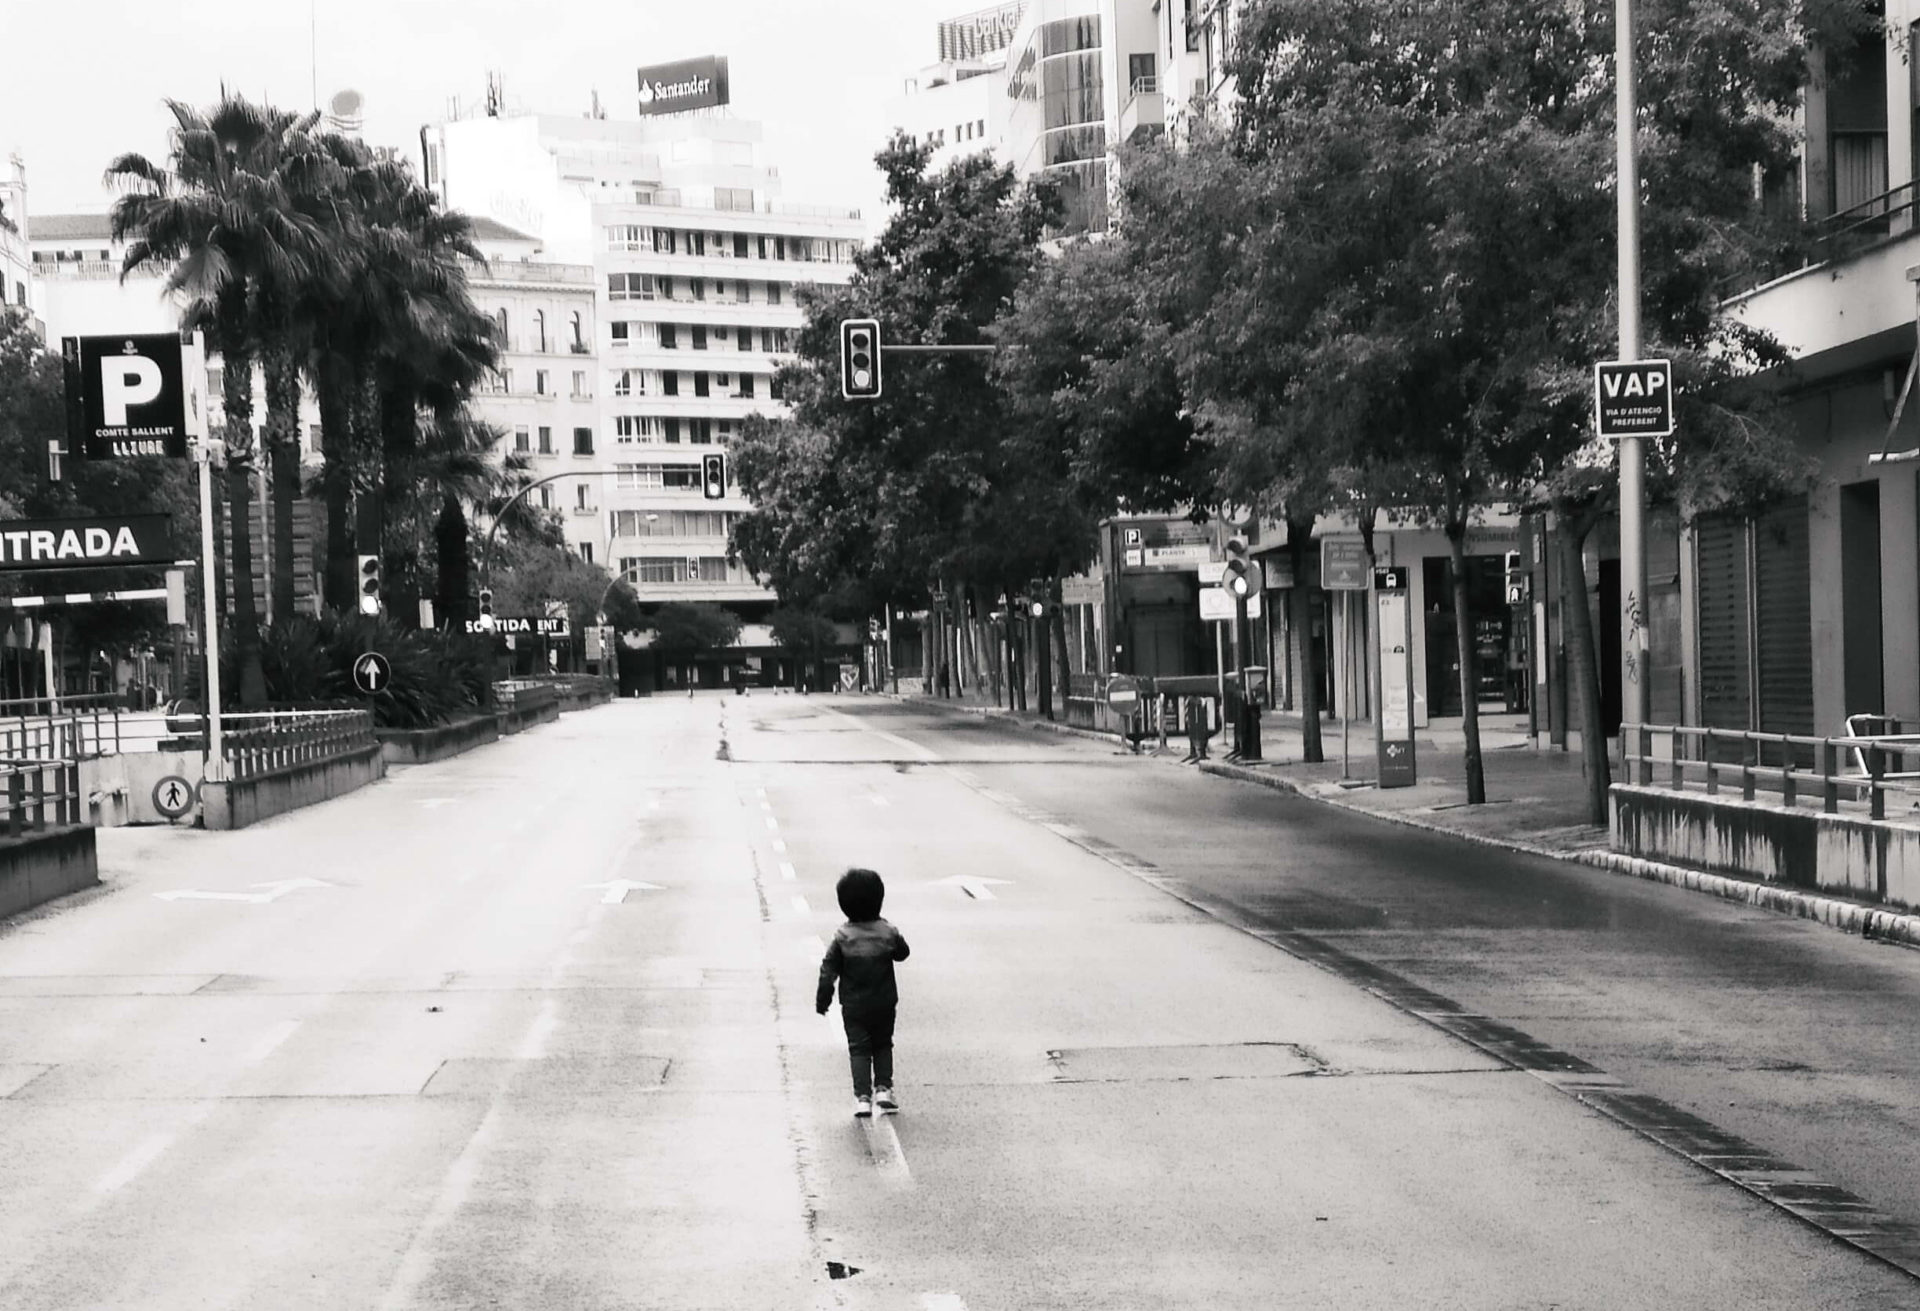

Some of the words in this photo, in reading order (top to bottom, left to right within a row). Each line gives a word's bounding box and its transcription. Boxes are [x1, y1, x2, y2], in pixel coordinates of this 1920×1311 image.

[654, 74, 710, 100] Santander
[100, 355, 163, 426] P
[1603, 371, 1665, 398] VAP
[95, 428, 129, 437] COMTE
[131, 426, 174, 436] SALLENT
[1612, 417, 1657, 426] PREFERENT
[112, 440, 165, 456] LLIURE
[0, 526, 140, 562] TRADA
[465, 619, 531, 634] SOTIDA
